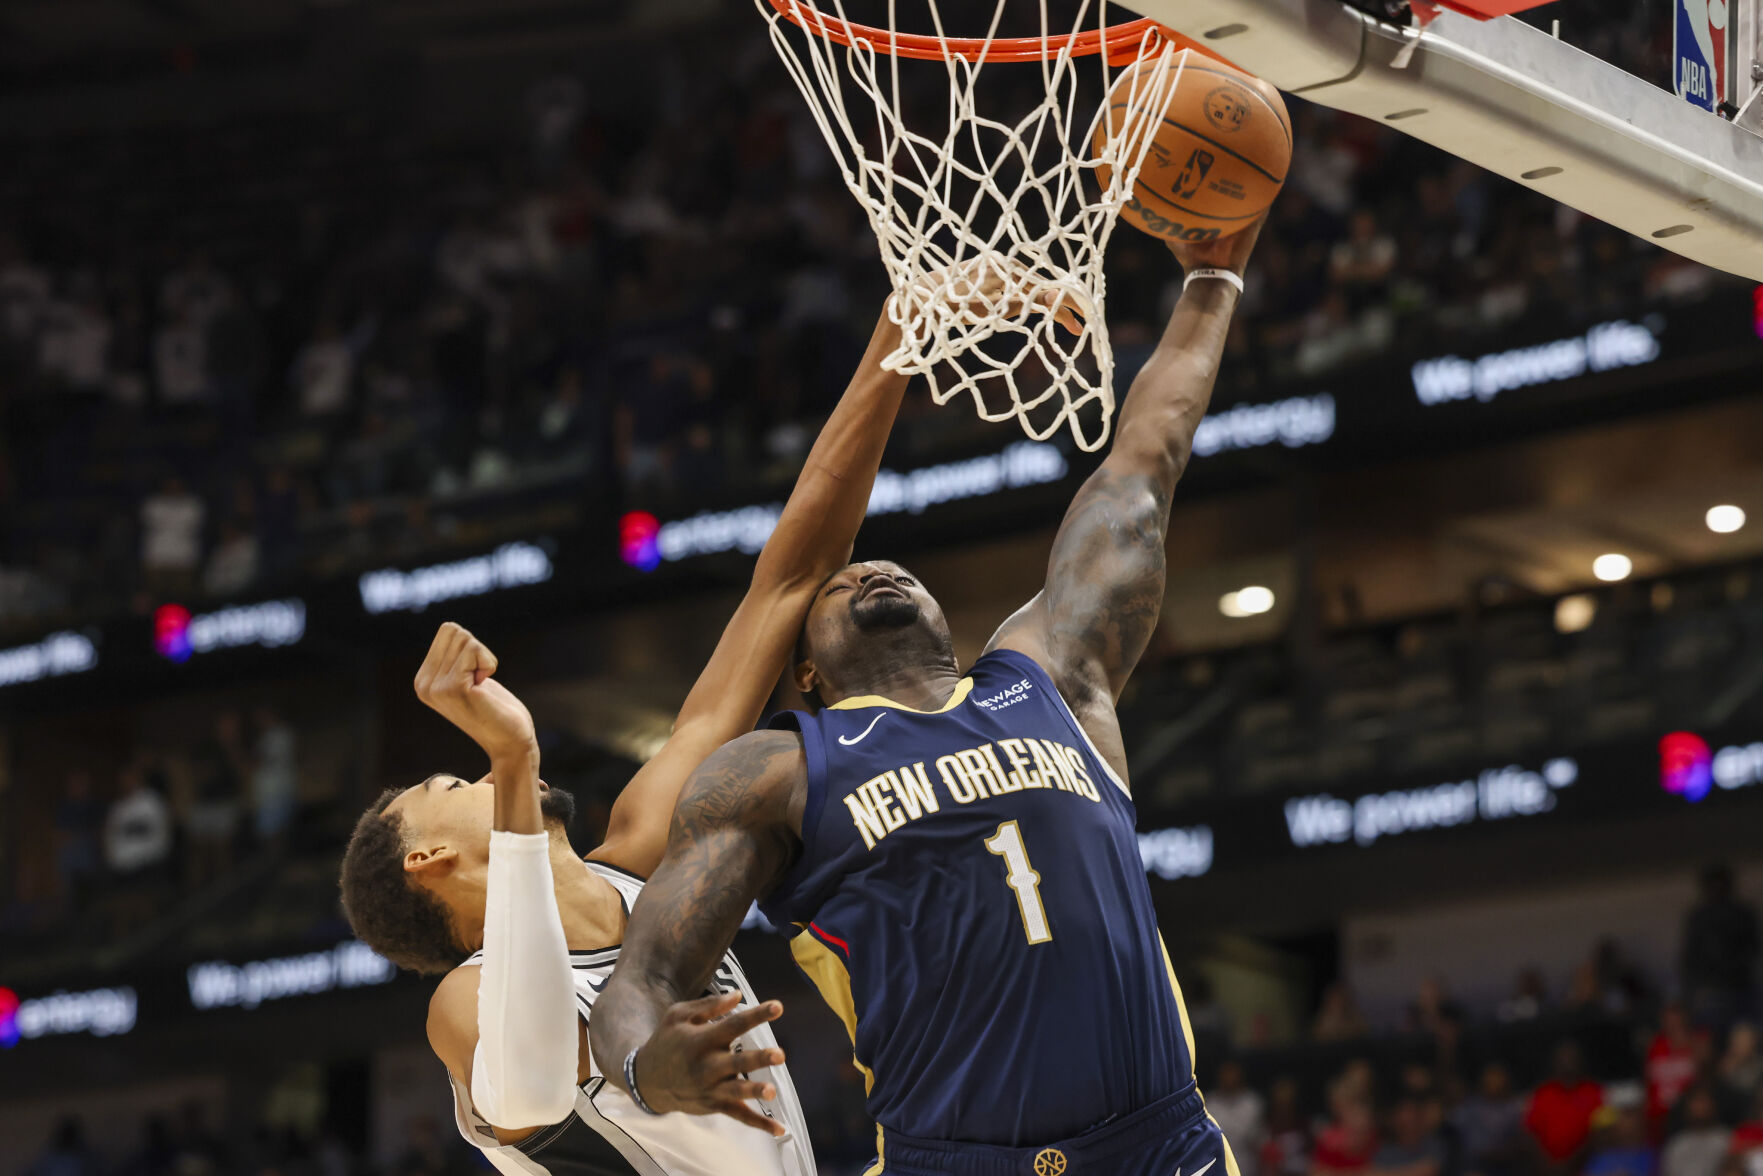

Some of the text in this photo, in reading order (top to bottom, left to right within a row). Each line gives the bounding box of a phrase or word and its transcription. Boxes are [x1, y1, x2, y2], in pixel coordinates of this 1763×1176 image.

[1681, 56, 1707, 100] NBA
[1125, 199, 1222, 241] Wilso
[990, 692, 1029, 711] GARAGE
[842, 761, 940, 851] NEW
[935, 738, 1101, 803] ORLEANS
[983, 819, 1053, 945] 1
